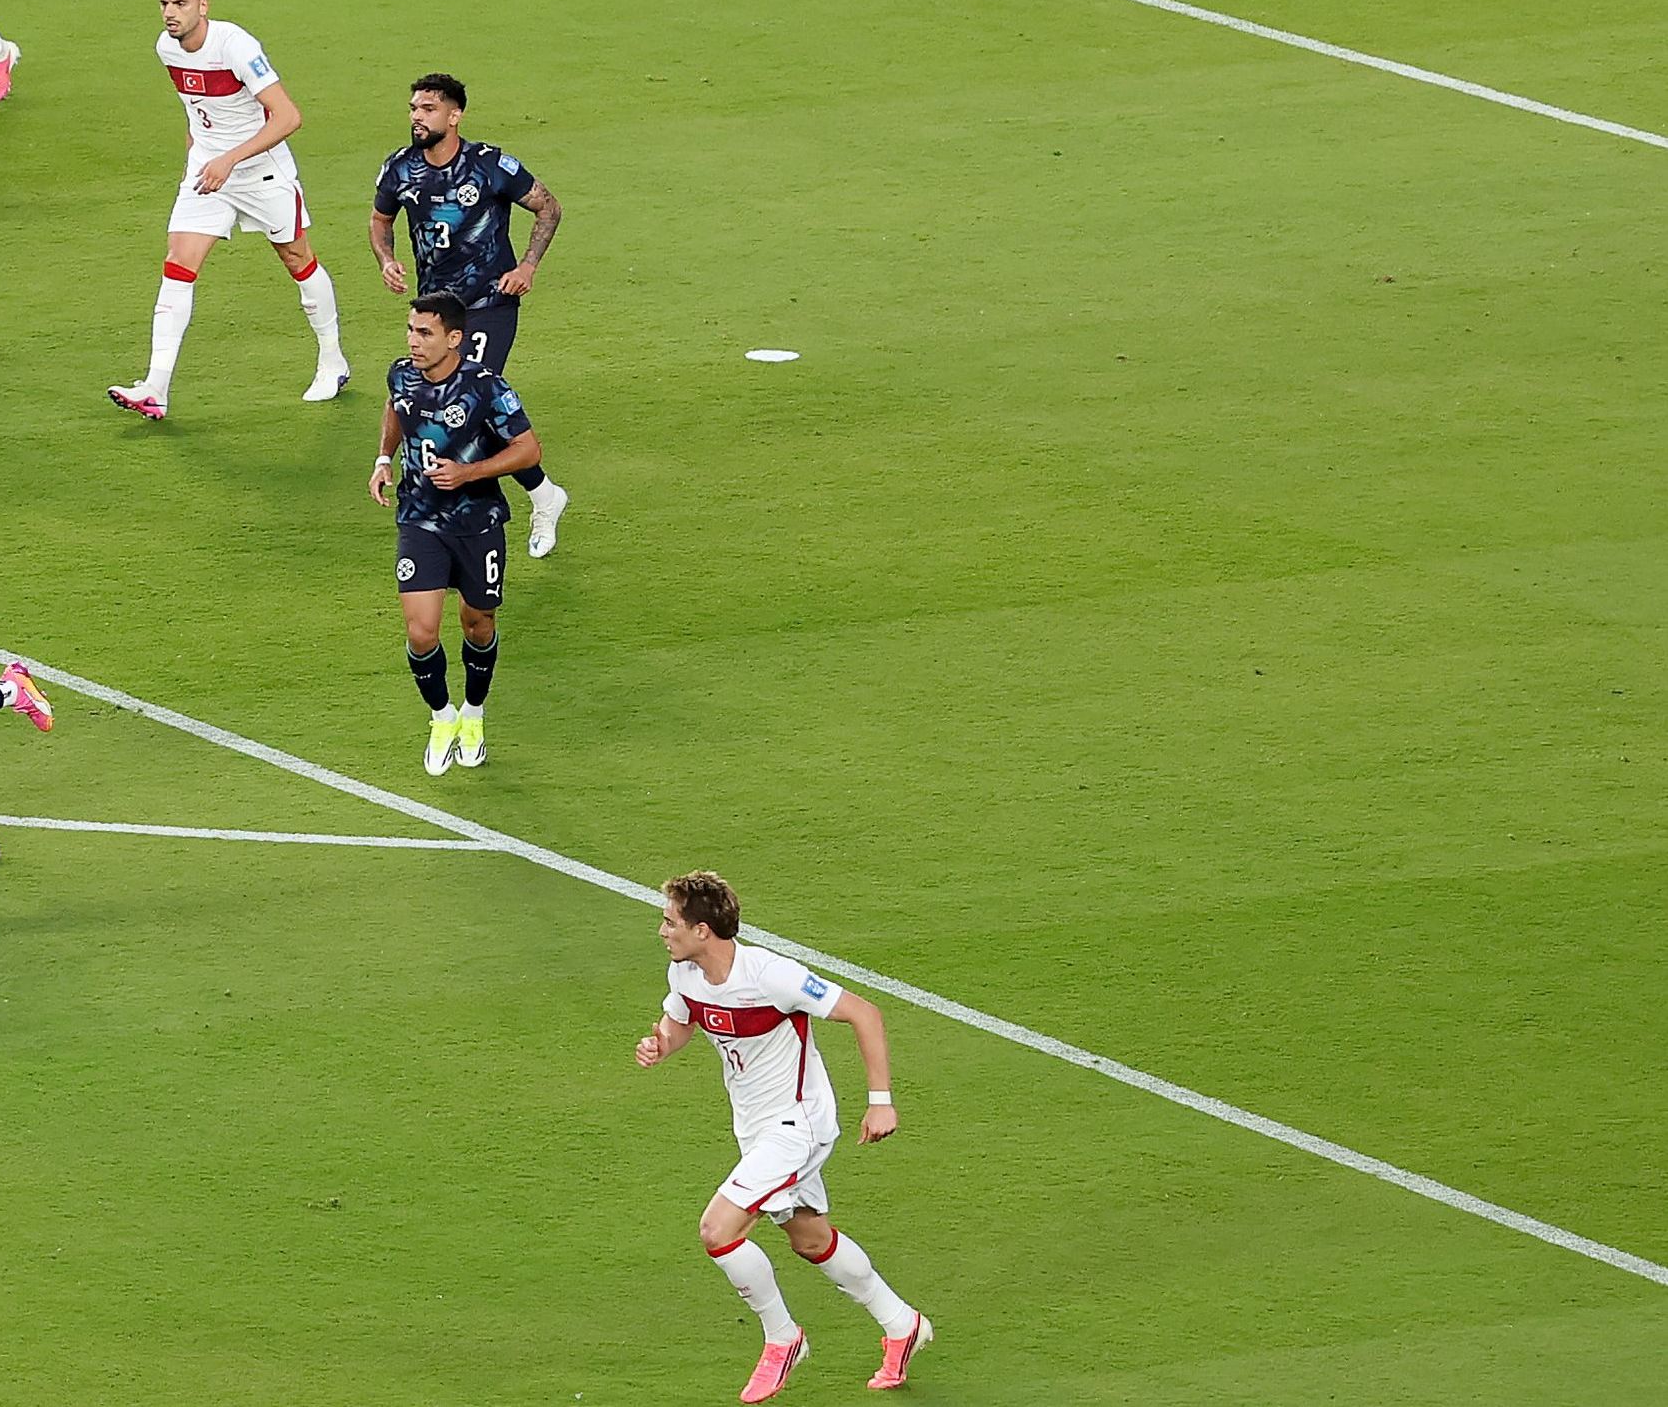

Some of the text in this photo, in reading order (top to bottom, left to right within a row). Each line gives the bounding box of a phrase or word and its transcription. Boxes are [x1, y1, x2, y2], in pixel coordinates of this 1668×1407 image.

[196, 107, 212, 130] 3
[434, 220, 451, 250] 3
[466, 330, 489, 364] 3
[420, 438, 440, 472] 6
[484, 548, 500, 585] 6
